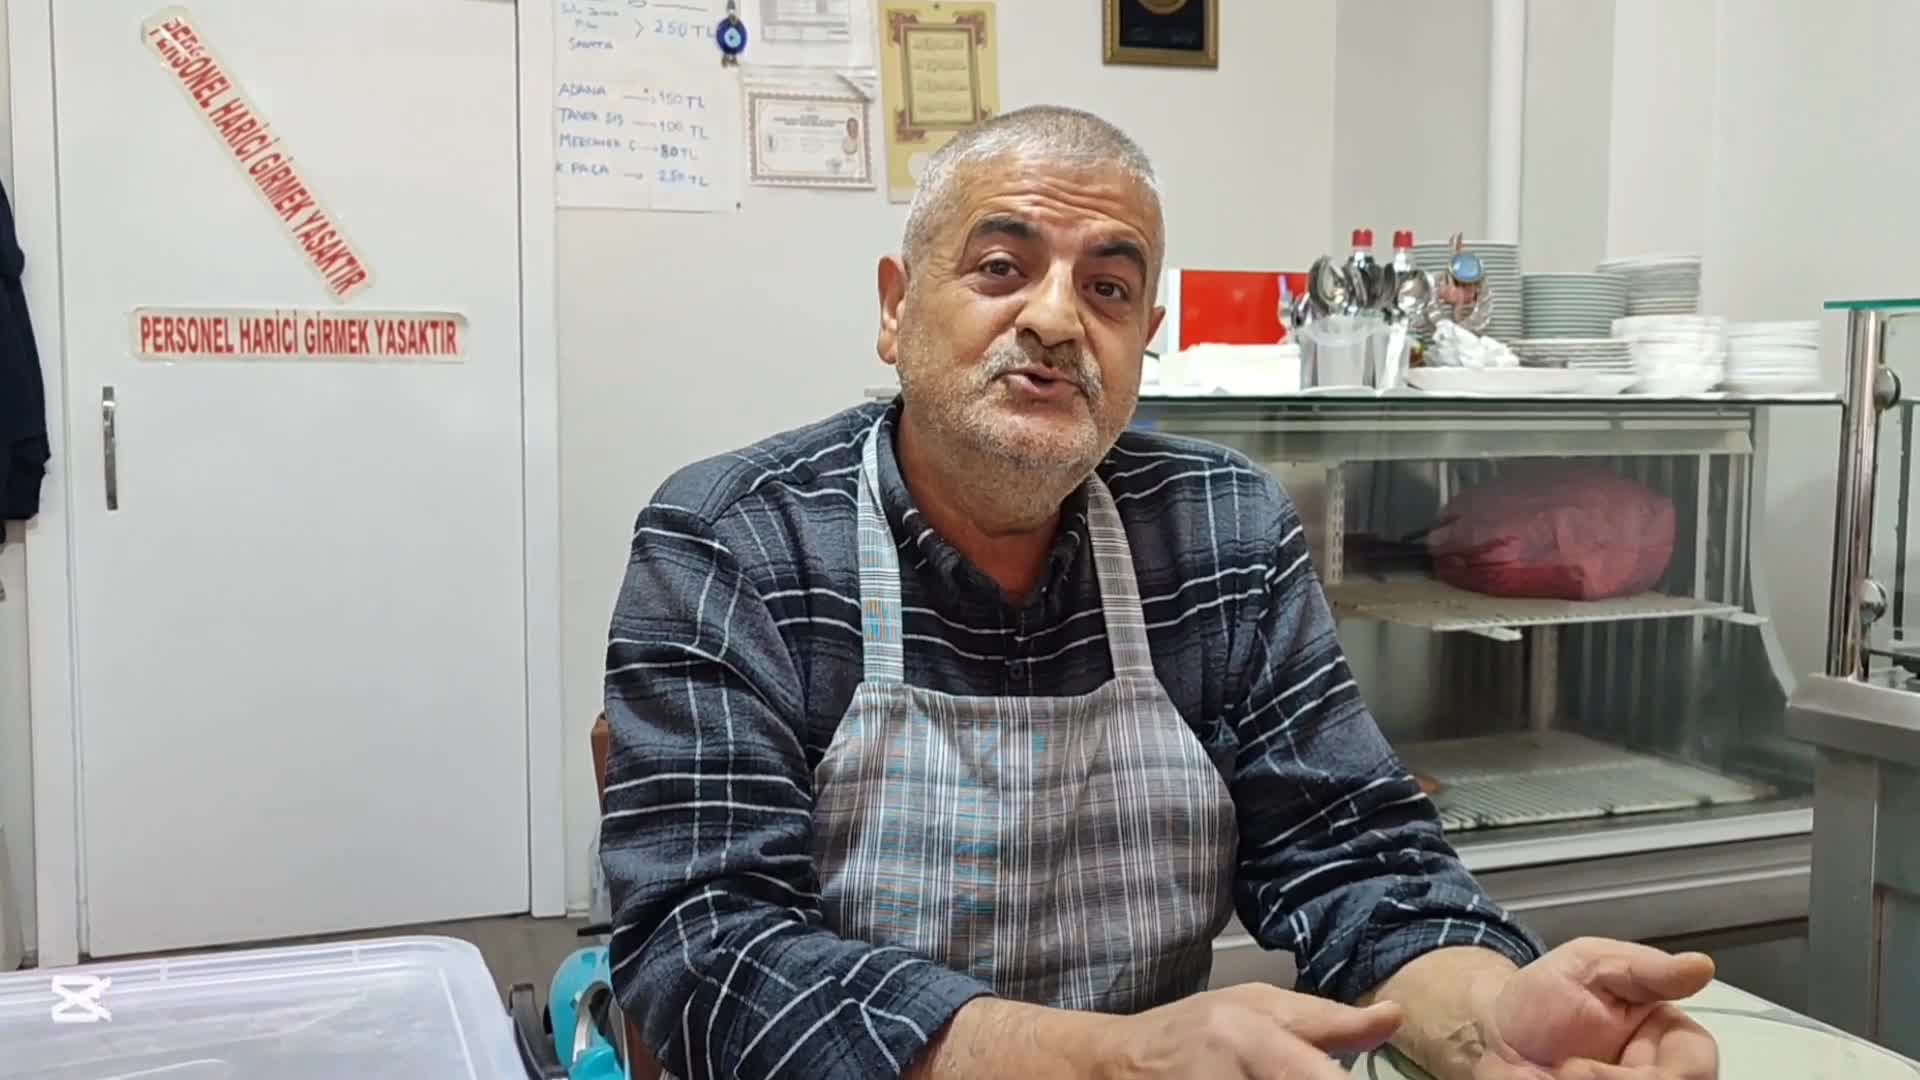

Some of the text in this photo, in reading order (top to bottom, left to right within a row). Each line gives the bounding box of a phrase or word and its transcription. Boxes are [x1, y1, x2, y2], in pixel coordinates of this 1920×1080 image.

[558, 82, 606, 97] ADANA
[687, 95, 705, 109] TL
[689, 125, 710, 140] TL
[687, 174, 710, 187] TL
[208, 97, 280, 162] HARİCİ
[249, 156, 315, 222] GİRMEK
[291, 209, 366, 296] YASAKTIR
[141, 308, 457, 355] PERSONEL HARİCİ GİRMEK YASAKTIR
